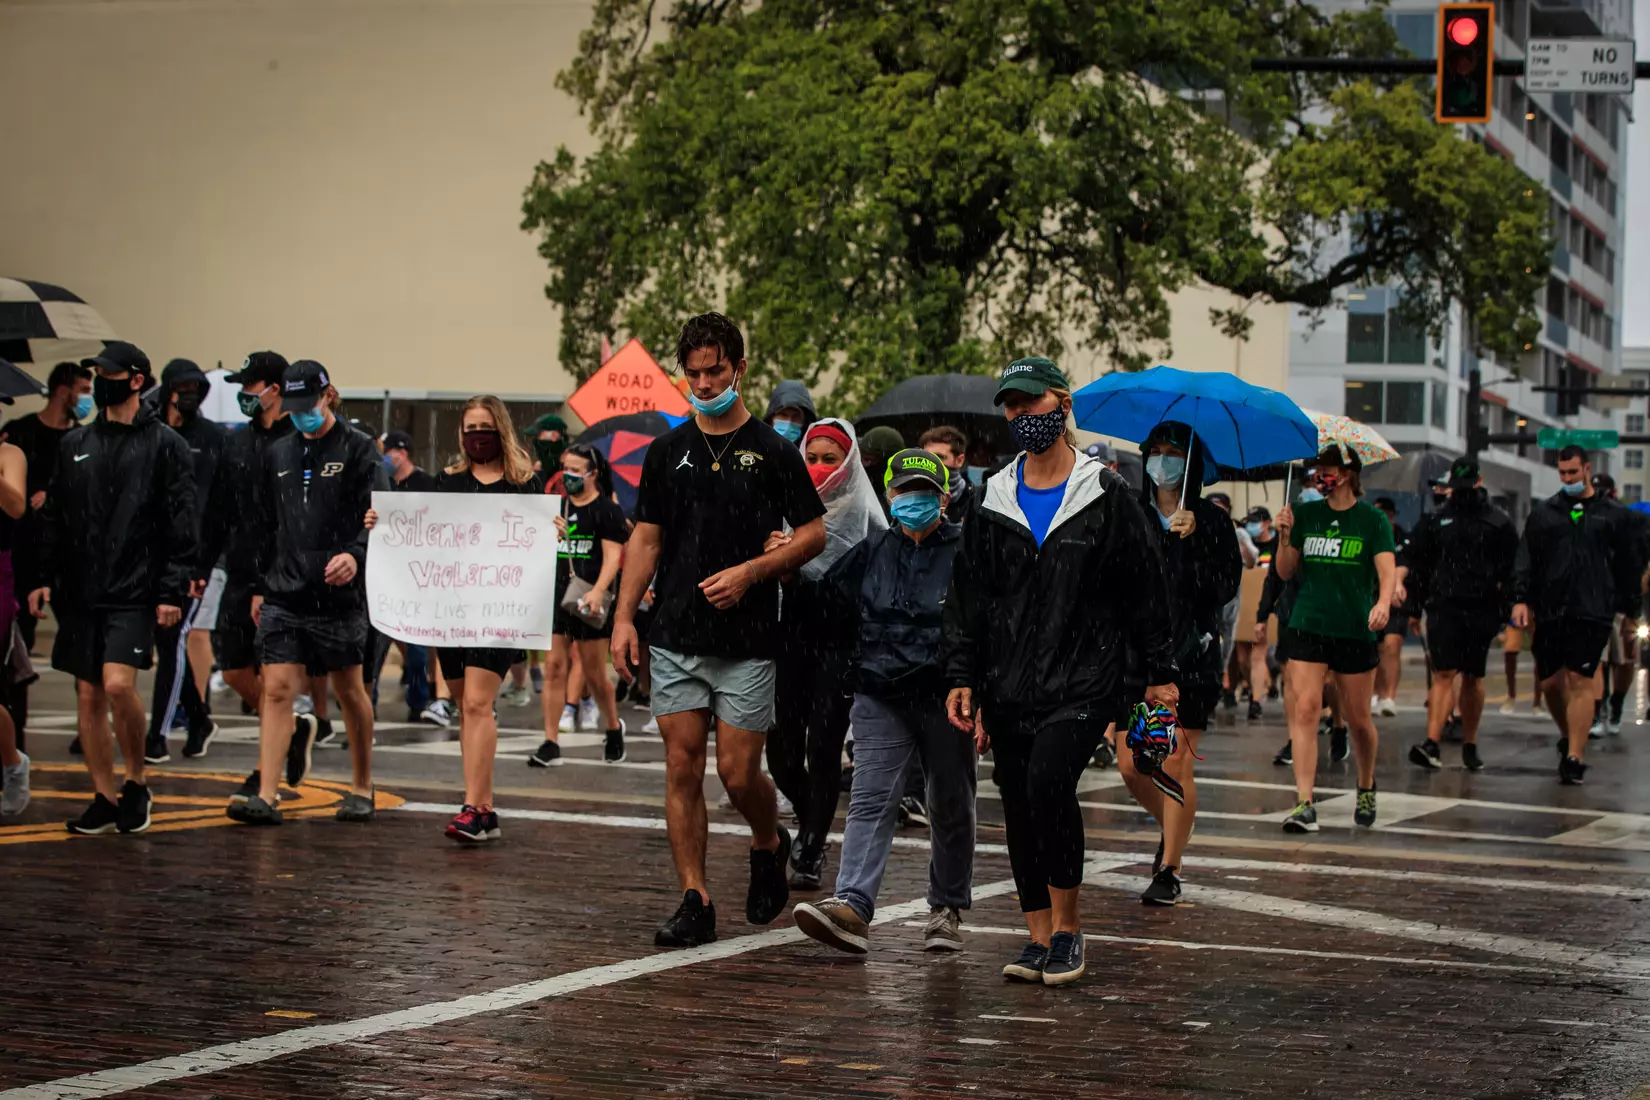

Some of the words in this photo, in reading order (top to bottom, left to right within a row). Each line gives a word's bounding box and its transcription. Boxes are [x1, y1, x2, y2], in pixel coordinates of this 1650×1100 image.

[1593, 47, 1618, 64] NO
[1581, 70, 1630, 85] TURNS
[1003, 364, 1033, 379] Tulane
[607, 372, 654, 389] ROAD
[606, 396, 652, 412] WORK
[320, 462, 344, 476] P
[903, 456, 937, 472] TULANE
[1341, 539, 1363, 558] UP
